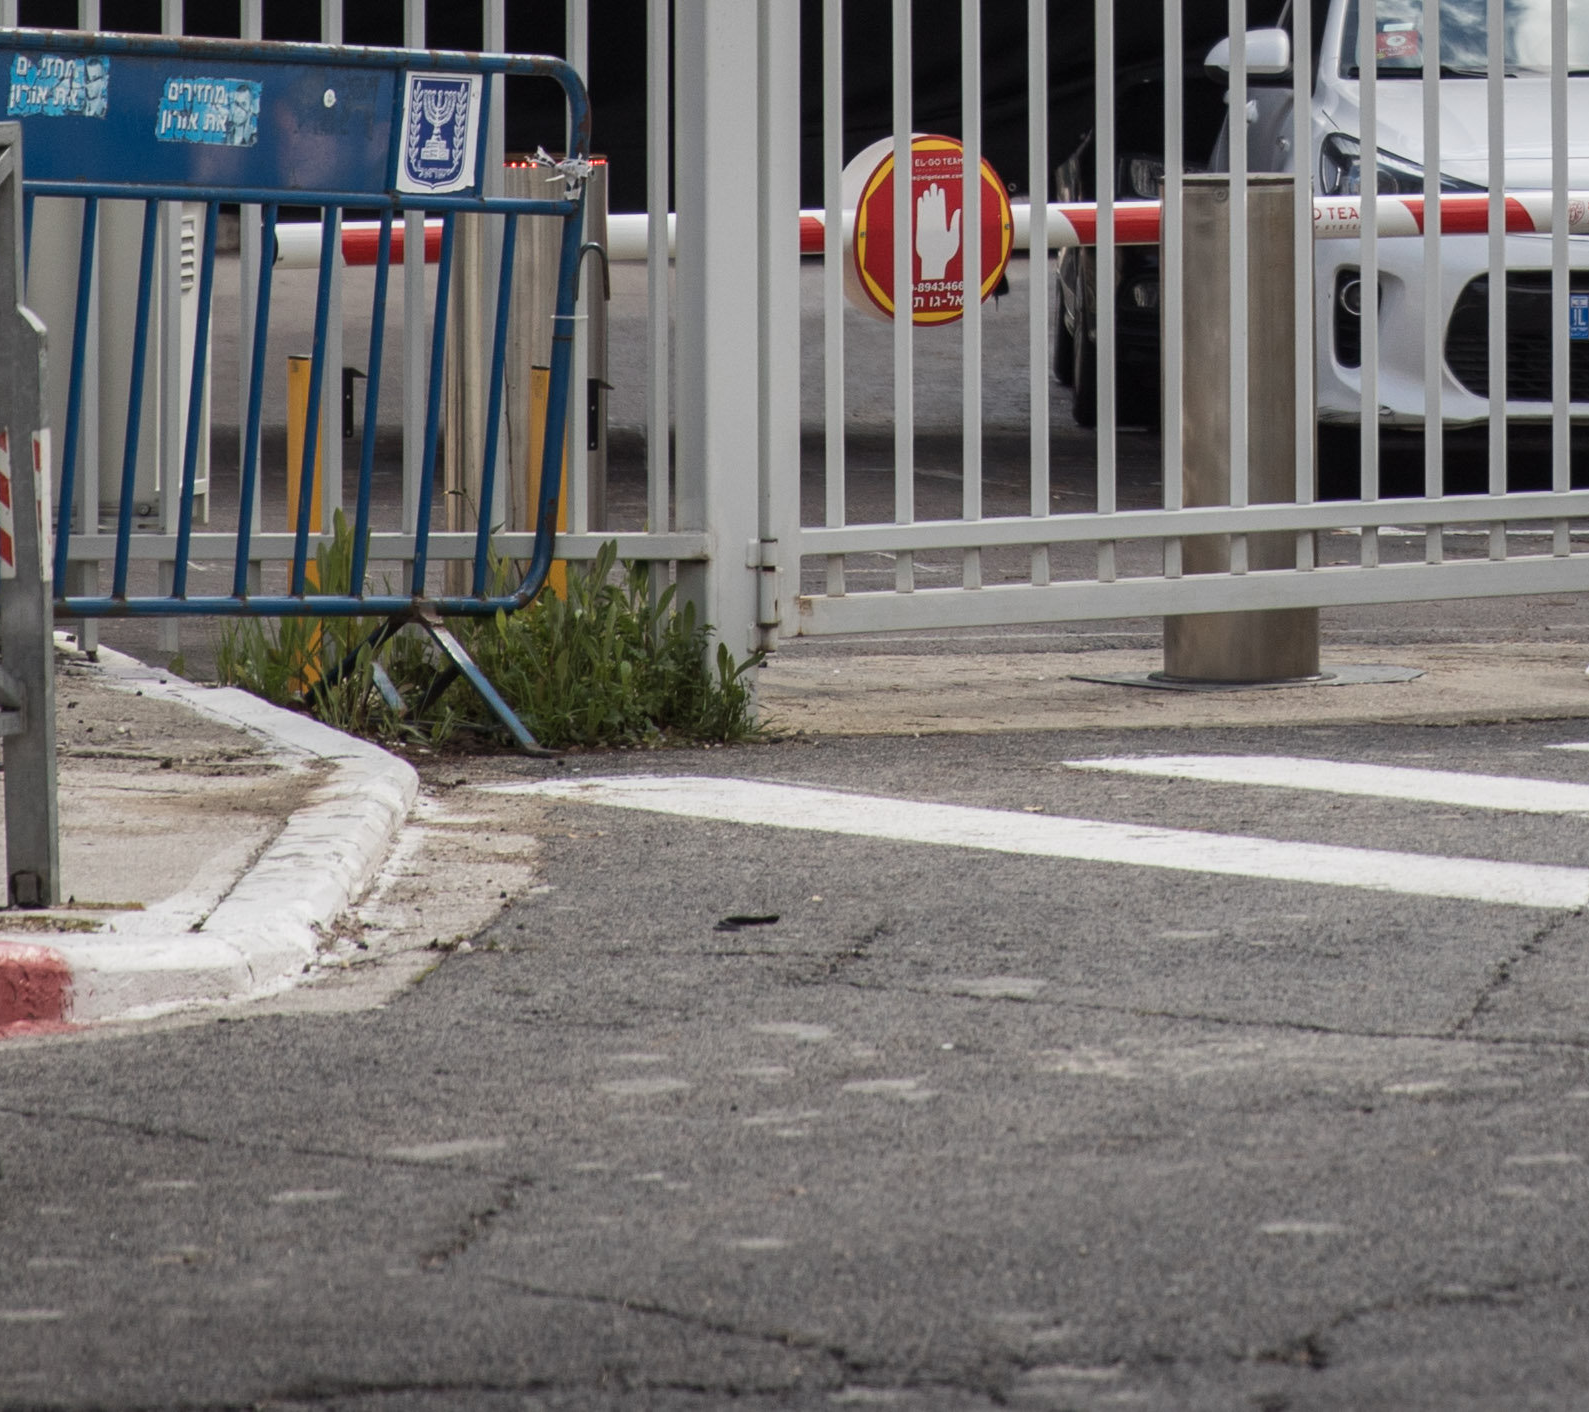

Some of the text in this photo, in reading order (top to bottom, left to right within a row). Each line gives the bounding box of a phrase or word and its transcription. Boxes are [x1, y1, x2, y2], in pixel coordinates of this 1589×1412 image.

[167, 81, 226, 105] מחזירים
[160, 108, 228, 135] את אורון
[1326, 207, 1360, 221] TEA
